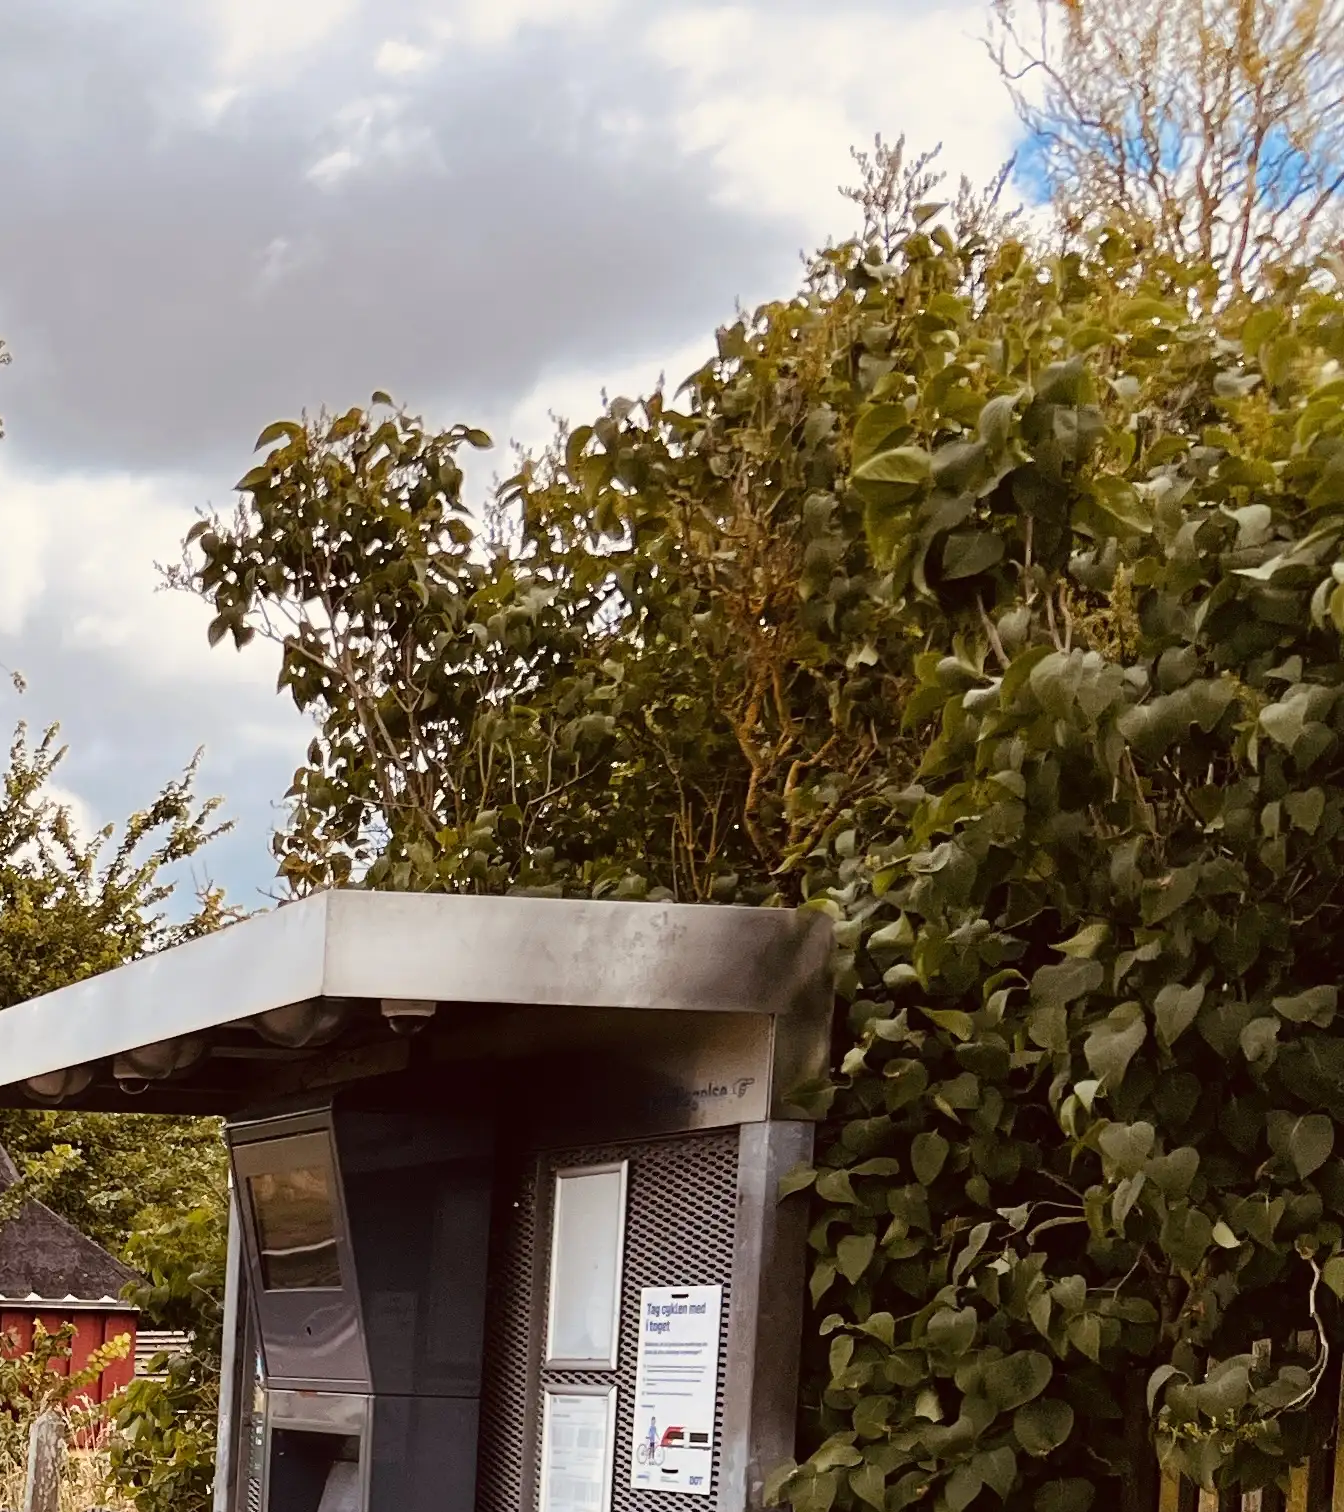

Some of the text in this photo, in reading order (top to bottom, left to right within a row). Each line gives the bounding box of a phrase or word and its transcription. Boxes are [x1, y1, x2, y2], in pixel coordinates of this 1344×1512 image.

[647, 1302, 706, 1317] Tag cyklen med
[649, 1321, 670, 1334] toget
